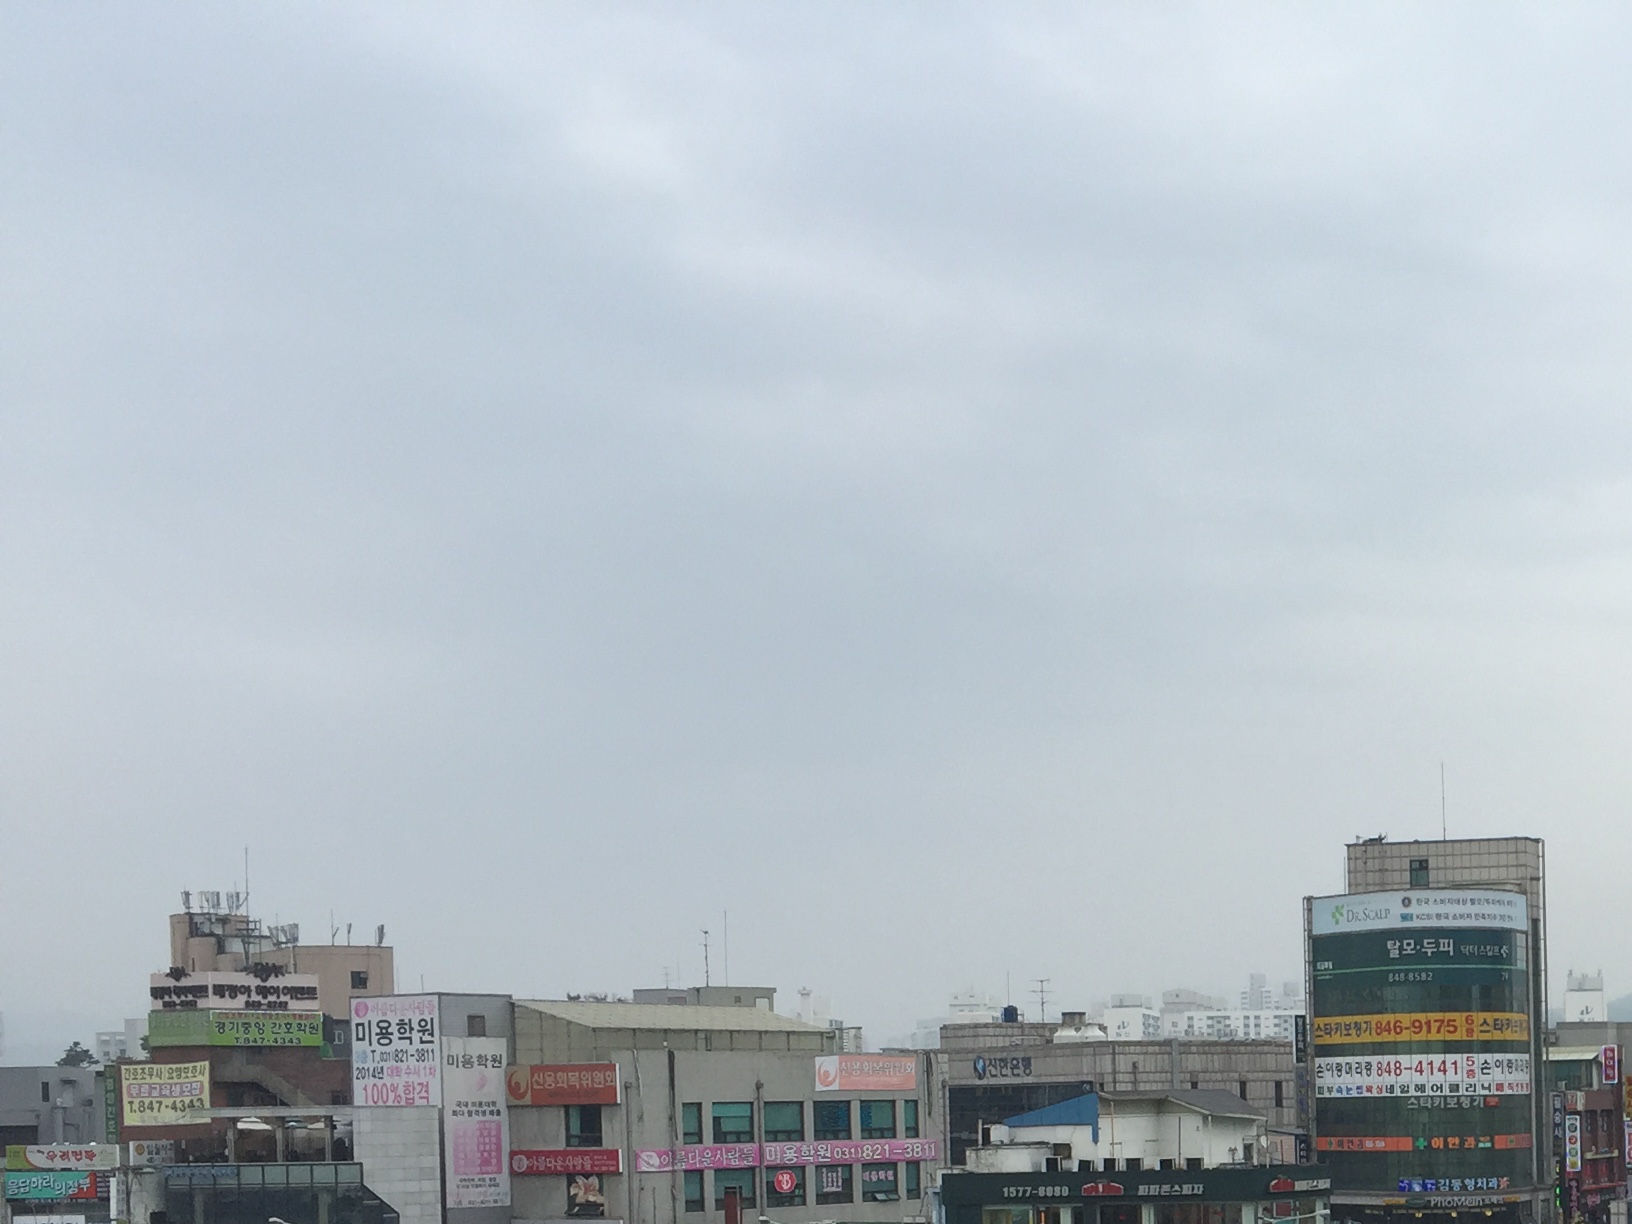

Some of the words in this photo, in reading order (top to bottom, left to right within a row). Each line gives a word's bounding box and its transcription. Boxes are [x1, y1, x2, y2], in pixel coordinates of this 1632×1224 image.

[355, 1017, 435, 1047] 미용학원
[1315, 1019, 1372, 1038] 스타키보청기
[1375, 1019, 1458, 1036] 846-9175
[447, 1053, 502, 1069] 미용학원
[987, 1056, 1033, 1077] 신한은행
[1376, 1059, 1459, 1077] 848-4141
[124, 1066, 162, 1081] 간호조무사
[355, 1066, 384, 1080] 2014년
[532, 1070, 616, 1089] 신용회복위원회
[1407, 1097, 1484, 1109] 스타키보청기
[527, 1154, 592, 1171] 아름다운사람들
[660, 1148, 756, 1168] 아름다운사람들
[766, 1144, 832, 1165] 미용학원
[7, 1173, 54, 1195] 응답하라
[55, 1177, 91, 1195] 의정부
[1137, 1183, 1204, 1196] 파파존스피자
